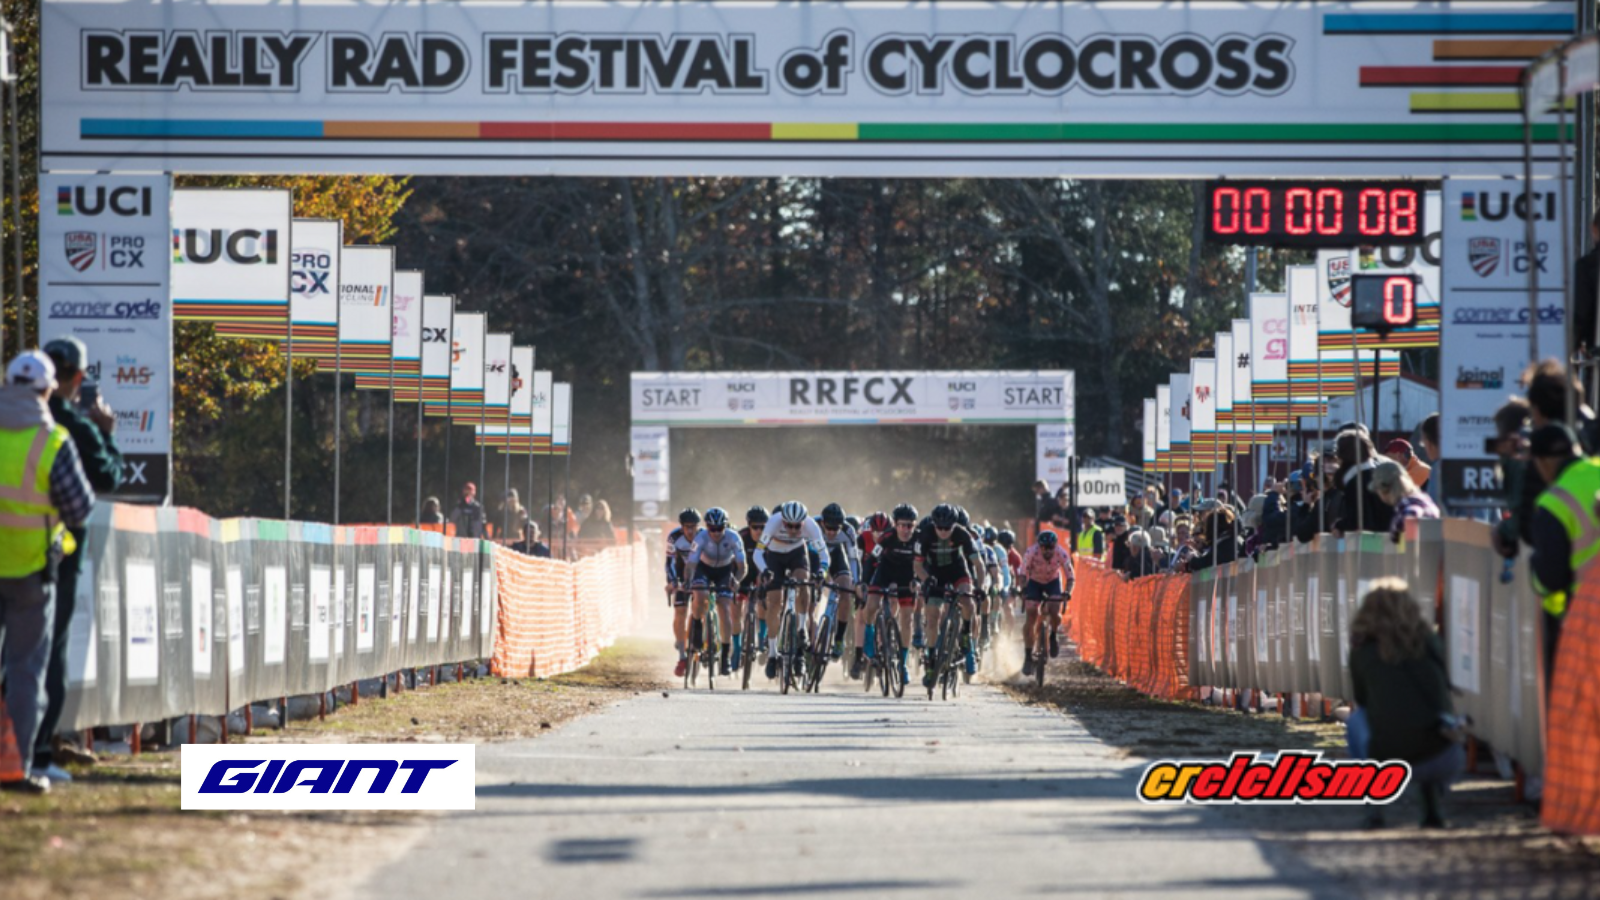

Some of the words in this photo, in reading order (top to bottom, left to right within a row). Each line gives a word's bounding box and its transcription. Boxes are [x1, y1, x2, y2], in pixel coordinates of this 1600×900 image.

[84, 33, 312, 88] REALLY
[328, 35, 467, 89] RAD
[486, 35, 764, 90] FESTIVAL
[780, 32, 850, 90] of
[866, 37, 1291, 91] CYCLOCROSS
[74, 185, 152, 216] UCI
[1478, 191, 1556, 222] UCI
[1213, 187, 1270, 234] 00
[1285, 187, 1343, 235] 00
[1358, 187, 1417, 236] 08
[110, 235, 145, 249] PRO
[184, 228, 278, 265] UCI
[1514, 241, 1549, 254] PO
[110, 250, 145, 268] CX
[51, 301, 111, 316] corner
[114, 298, 161, 319] cycle
[1383, 276, 1414, 325] 0
[1454, 306, 1514, 321] corner
[422, 328, 447, 342] CX
[116, 366, 150, 385] MS
[731, 382, 756, 392] UCI
[789, 377, 916, 406] RRFCX
[952, 381, 976, 392] UCI
[1004, 387, 1064, 405] START
[642, 388, 702, 407] START
[1076, 479, 1121, 495] 00m
